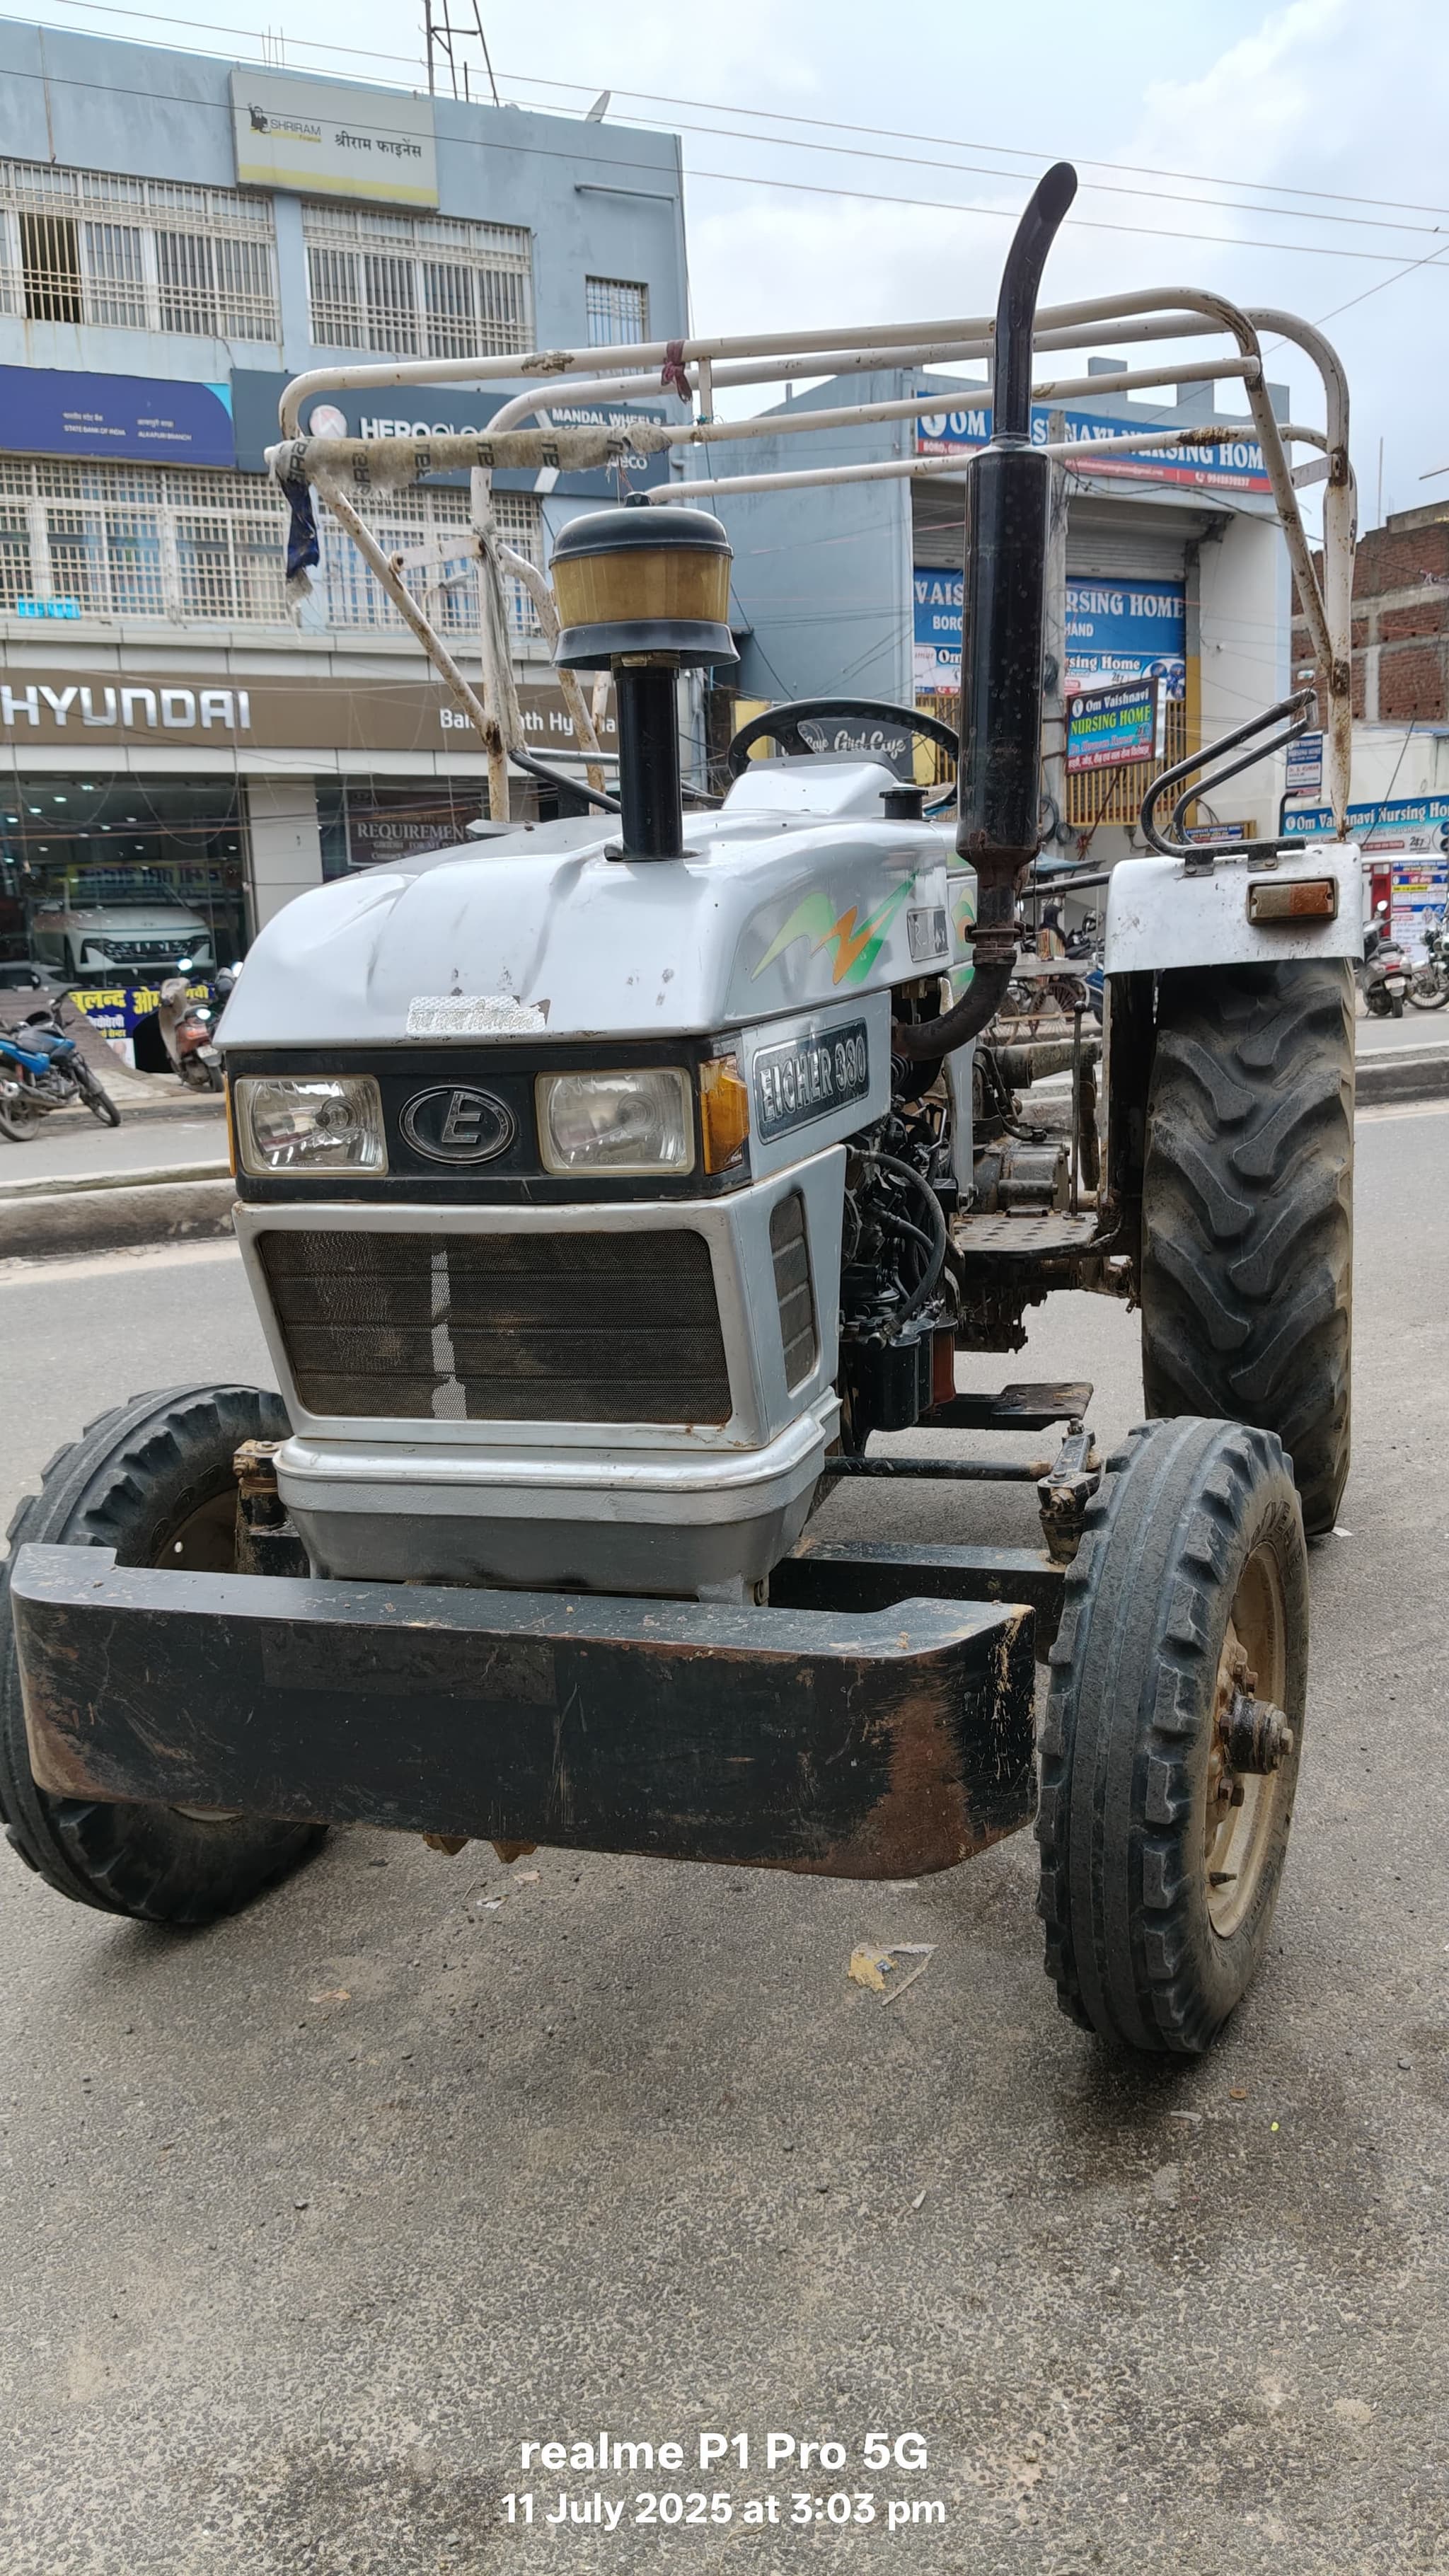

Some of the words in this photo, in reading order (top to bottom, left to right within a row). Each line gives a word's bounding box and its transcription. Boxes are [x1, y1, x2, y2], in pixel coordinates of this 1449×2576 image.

[270, 119, 321, 136] SHRIRAM
[335, 130, 371, 151] श्रीराम
[552, 408, 607, 424] MANDAL
[949, 410, 986, 437] OM
[1219, 443, 1264, 470] HOM
[1130, 595, 1184, 618] HOME
[1068, 655, 1098, 671] sing
[1101, 656, 1141, 671] Home
[0, 685, 251, 729] HYUNDAI
[1085, 700, 1102, 713] Om
[1104, 687, 1150, 708] Vaishnavi
[1070, 712, 1117, 737] NURSING
[1119, 705, 1151, 727] HOME
[1296, 817, 1315, 831] Om
[1379, 805, 1426, 824] Nursing
[357, 823, 465, 841] REQUIREMEN
[758, 1046, 834, 1124] EICHER
[834, 1034, 866, 1092] 380
